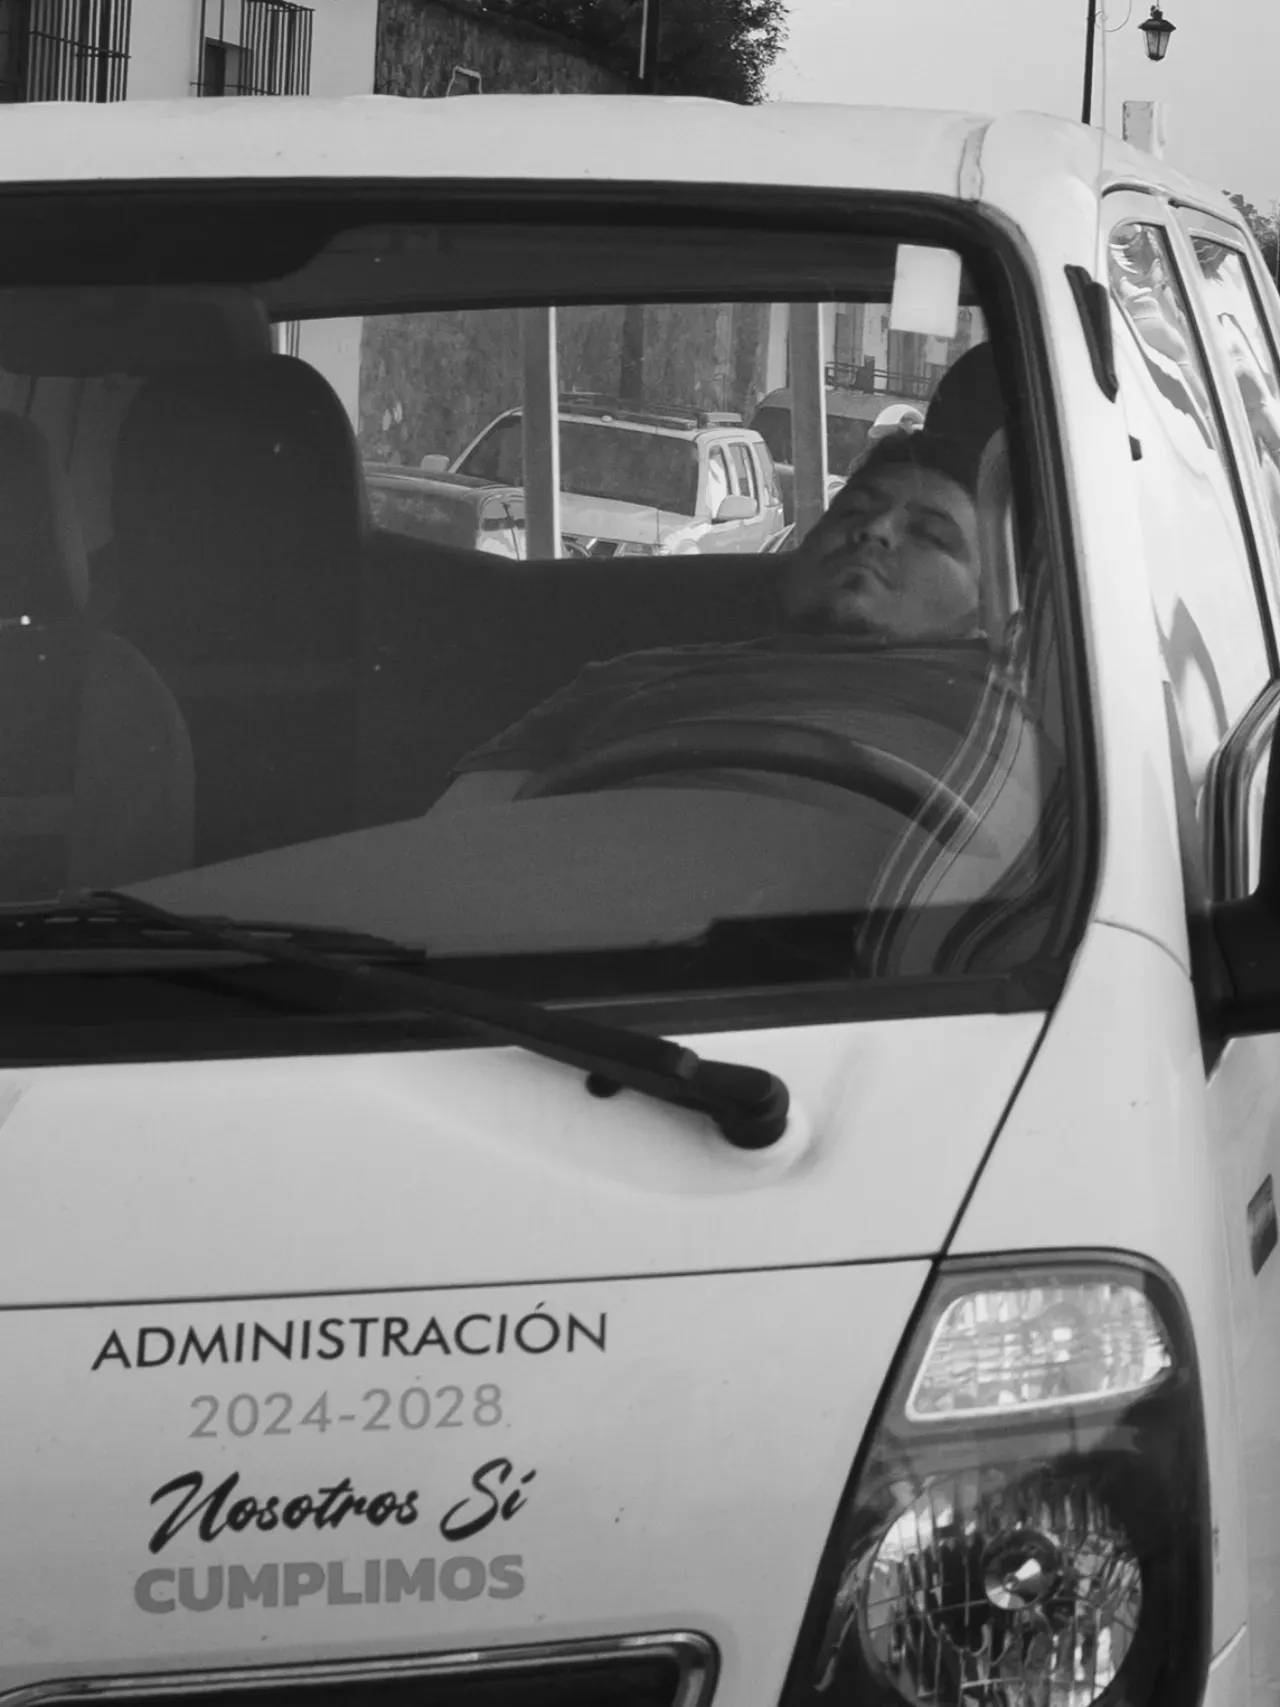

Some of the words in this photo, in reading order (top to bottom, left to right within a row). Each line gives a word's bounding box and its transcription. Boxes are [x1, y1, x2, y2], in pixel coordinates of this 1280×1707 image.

[92, 1302, 607, 1370] ADMINISTRACIÓN
[189, 1383, 504, 1438] 2024-2028
[148, 1471, 419, 1554] Nosotros
[440, 1457, 537, 1542] Sí
[134, 1554, 525, 1614] CUMPLIMOS
